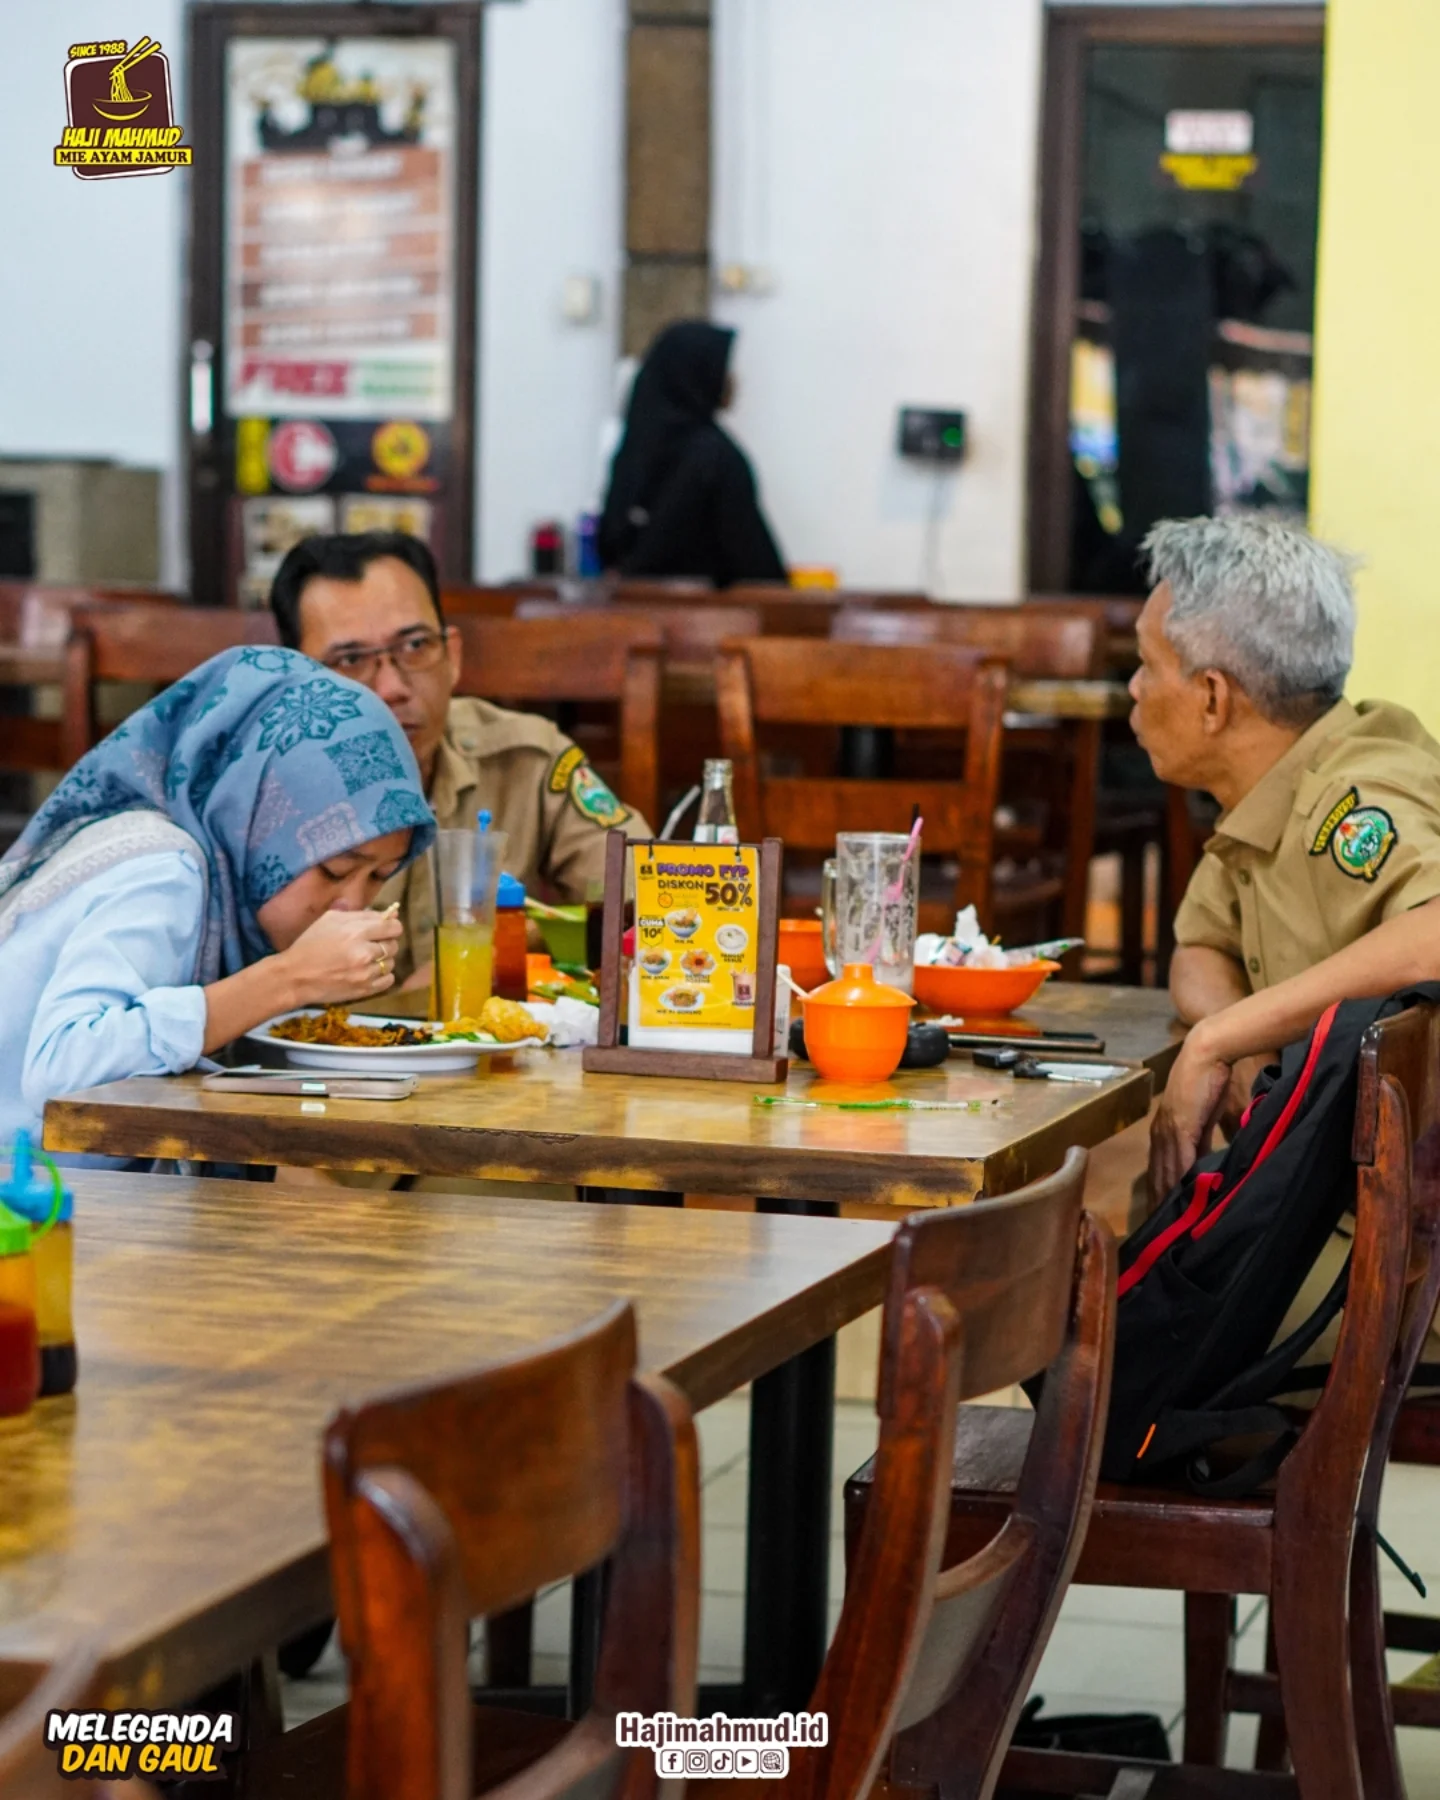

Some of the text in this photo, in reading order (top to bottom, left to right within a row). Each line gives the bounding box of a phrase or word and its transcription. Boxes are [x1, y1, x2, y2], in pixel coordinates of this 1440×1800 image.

[656, 863, 715, 877] PROMO
[718, 864, 750, 878] FYP
[657, 879, 704, 890] DISKON
[704, 882, 753, 907] 50%
[639, 918, 664, 927] CUMA
